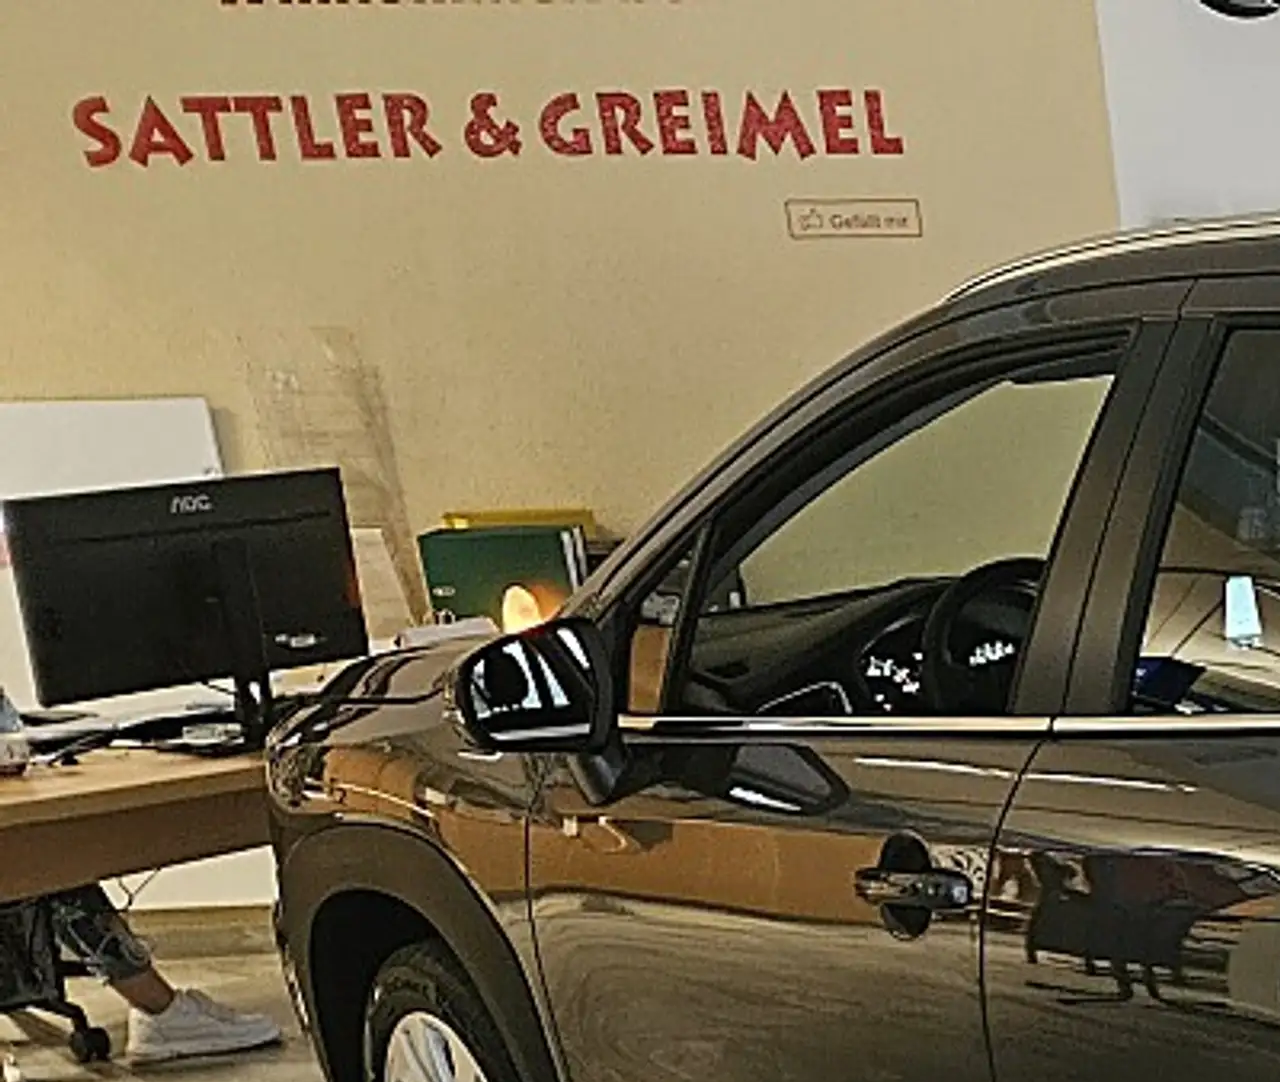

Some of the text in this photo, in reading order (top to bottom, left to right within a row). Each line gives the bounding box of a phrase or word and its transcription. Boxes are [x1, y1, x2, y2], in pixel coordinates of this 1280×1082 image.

[73, 89, 905, 167] SATTLER & GREIMEL
